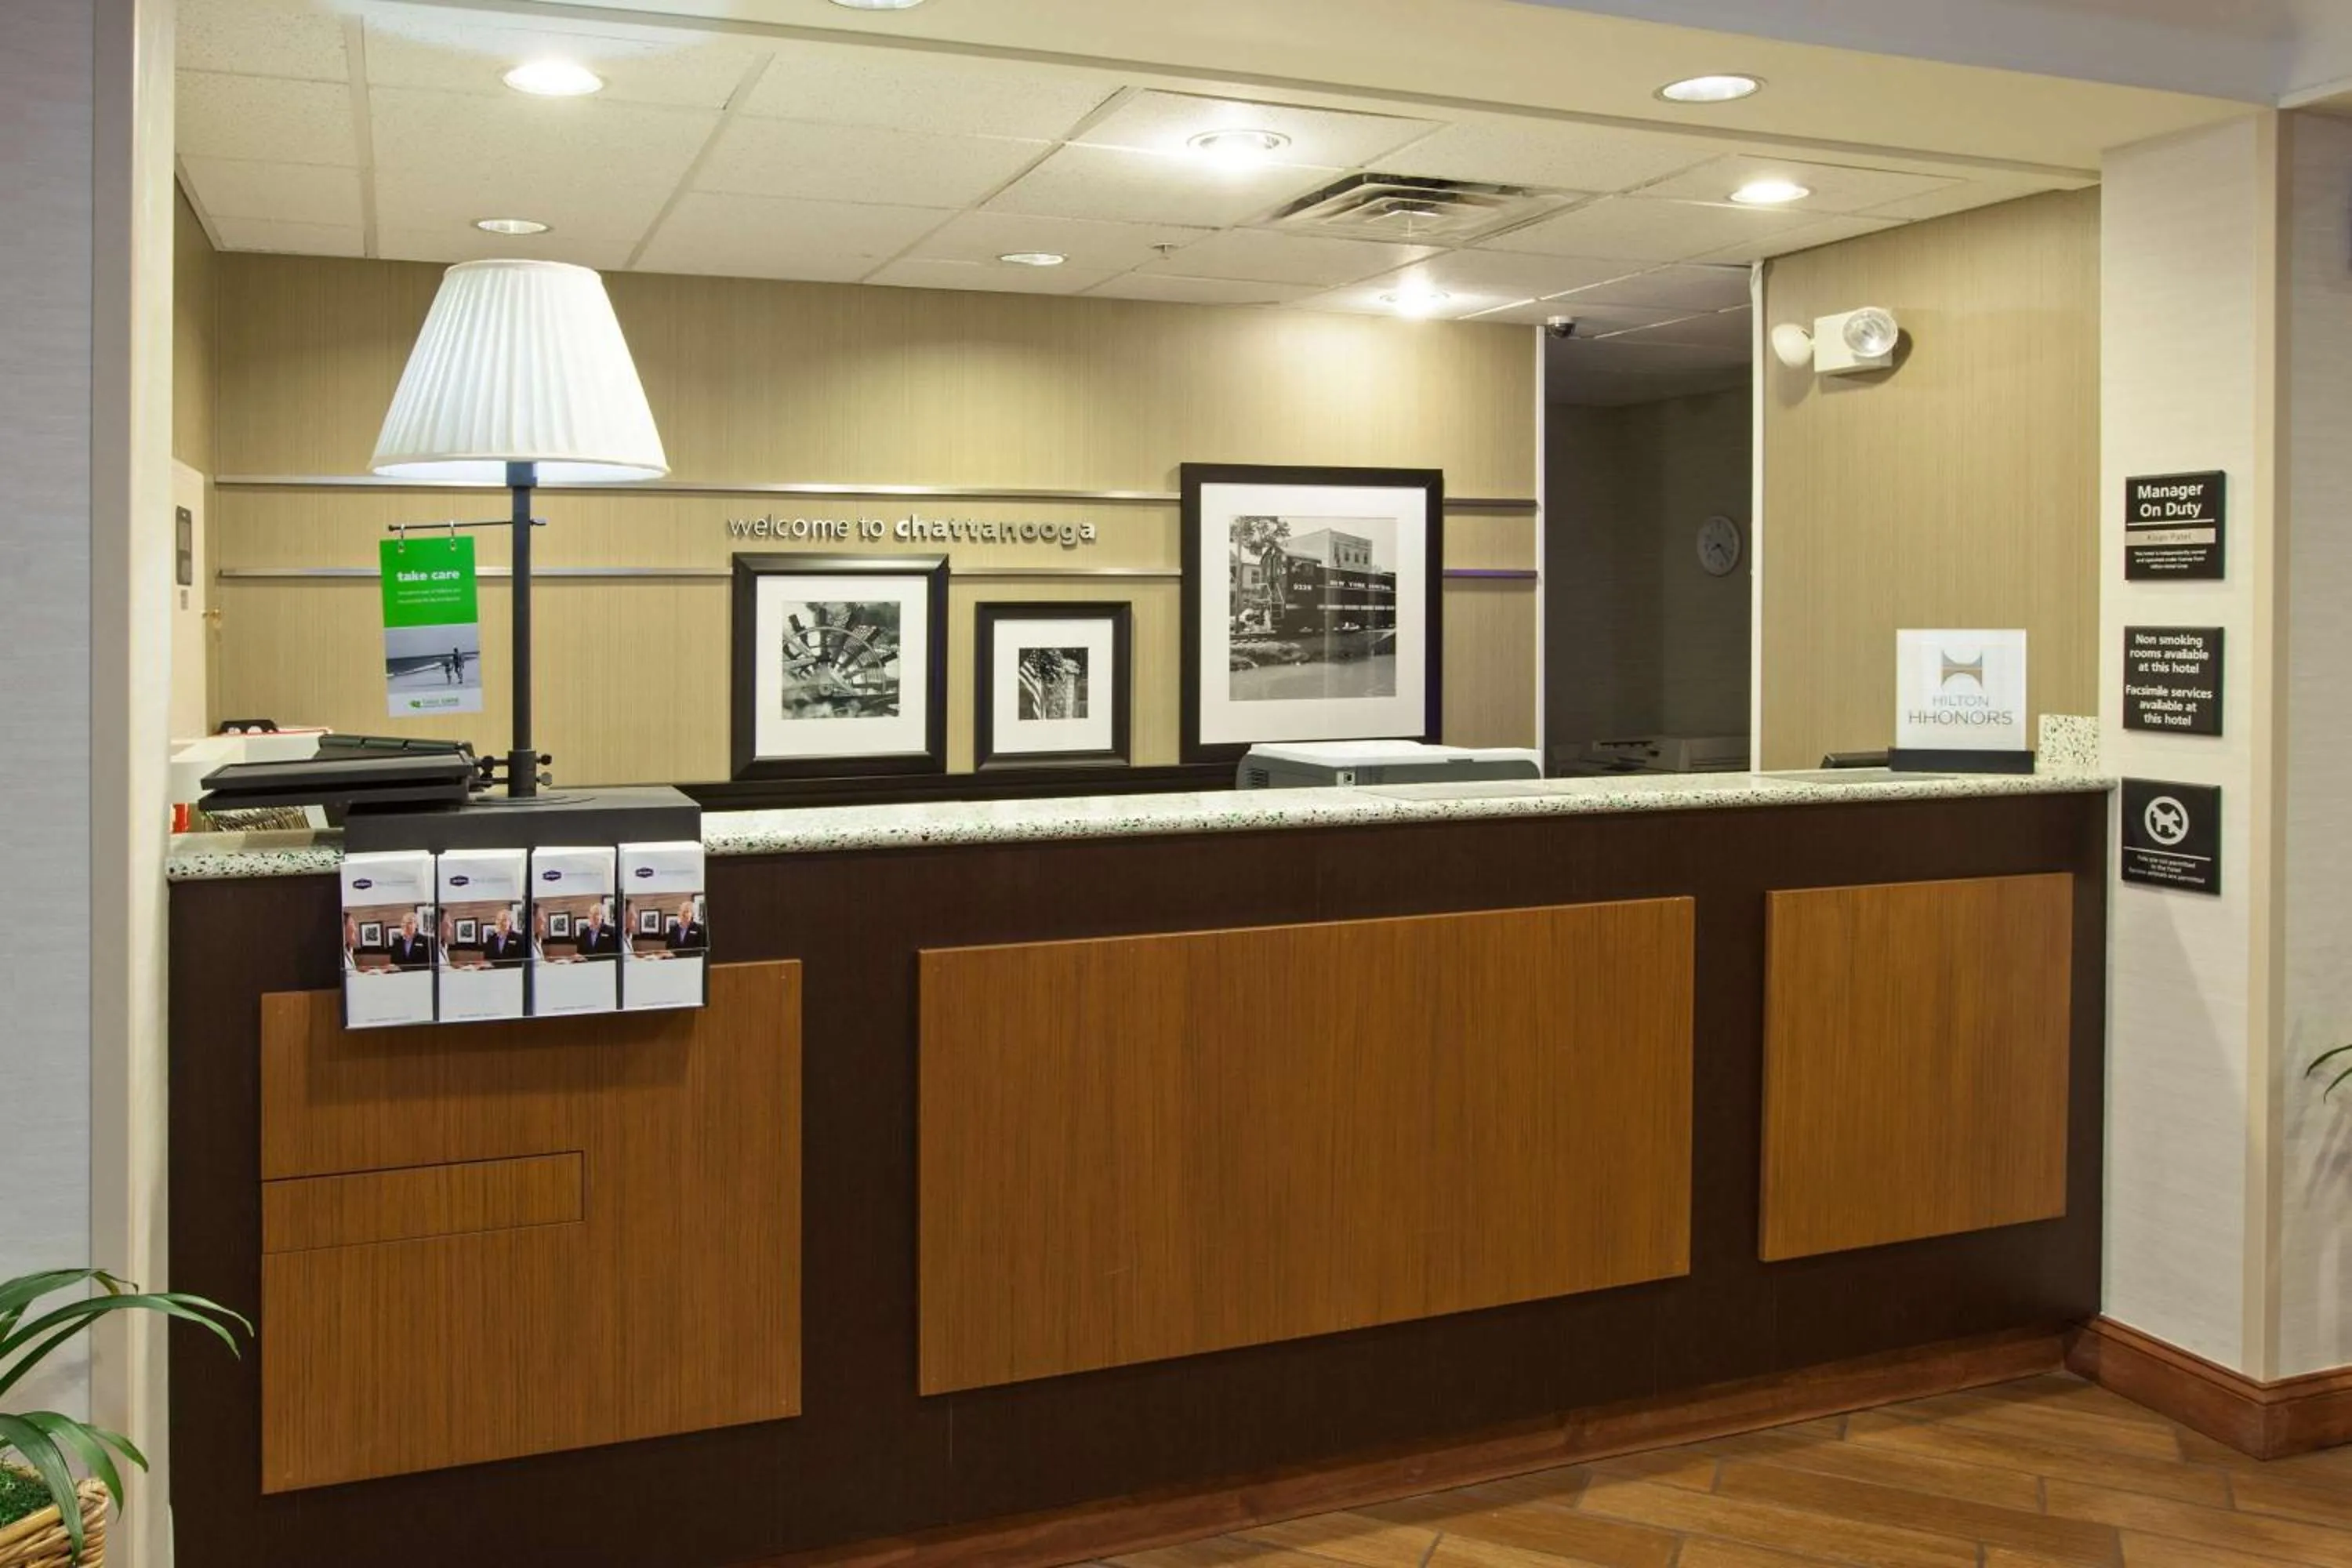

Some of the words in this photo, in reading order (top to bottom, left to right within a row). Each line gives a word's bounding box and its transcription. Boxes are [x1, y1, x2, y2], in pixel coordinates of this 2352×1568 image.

[2137, 484, 2204, 500] Manager
[2140, 503, 2161, 517] On
[2165, 502, 2201, 518] Duty
[728, 514, 848, 539] welcome
[859, 517, 885, 539] to
[895, 514, 1096, 547] chattanooga
[397, 570, 427, 582] take
[431, 570, 461, 580] care
[2135, 633, 2157, 645] Non
[2159, 634, 2204, 648] smoking
[2129, 650, 2162, 659] rooms
[2164, 648, 2209, 660] available
[2138, 662, 2150, 672] at
[2151, 662, 2170, 673] this
[2172, 662, 2199, 673] hotel
[2171, 686, 2212, 699] services
[1933, 695, 1989, 706] HILTON
[2139, 699, 2183, 712] available
[2185, 702, 2198, 713] at
[1908, 710, 2013, 725] HHONORS
[2143, 713, 2163, 724] this
[2165, 713, 2192, 726] hotel
